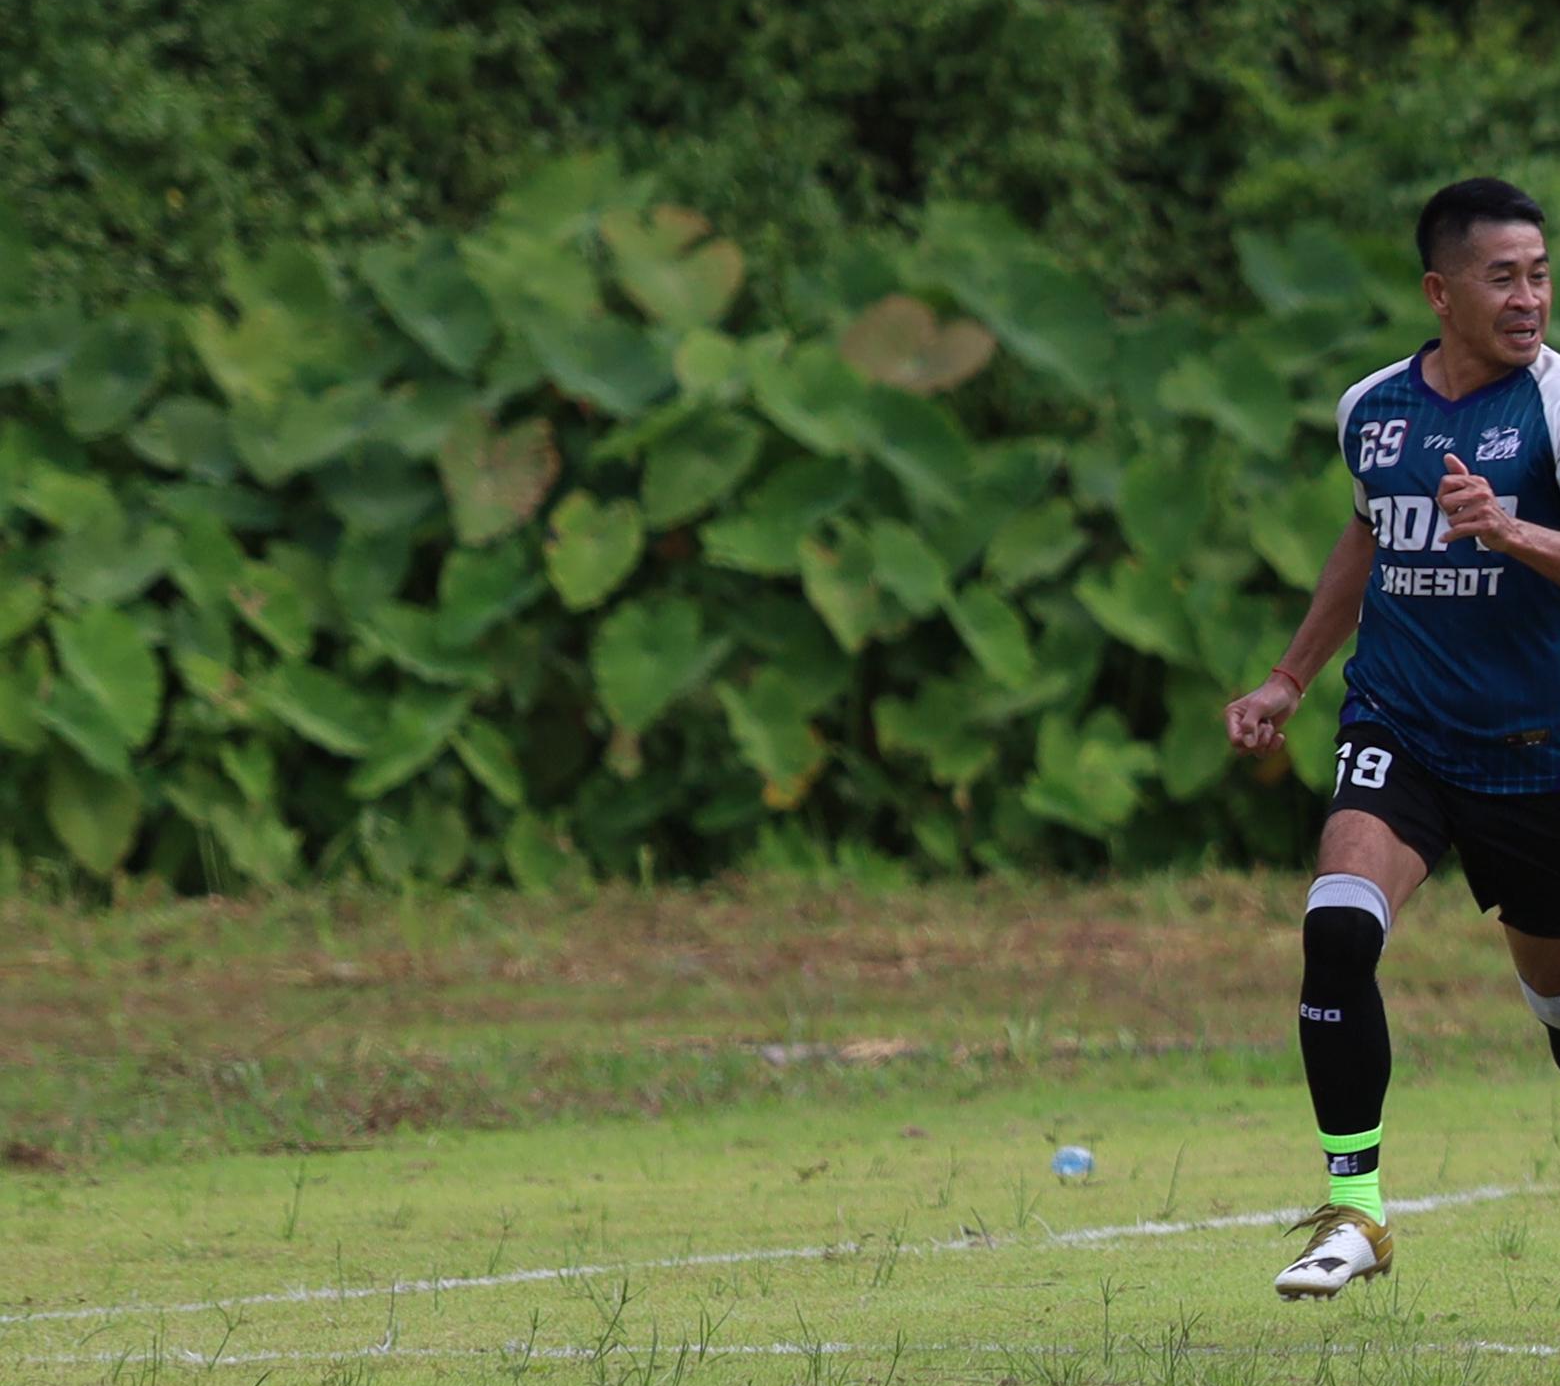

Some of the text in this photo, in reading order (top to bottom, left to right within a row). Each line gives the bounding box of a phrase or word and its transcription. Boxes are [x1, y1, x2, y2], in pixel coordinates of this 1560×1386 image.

[1359, 418, 1410, 473] 69
[1367, 494, 1519, 552] DO
[1300, 1002, 1342, 1023] EGO
